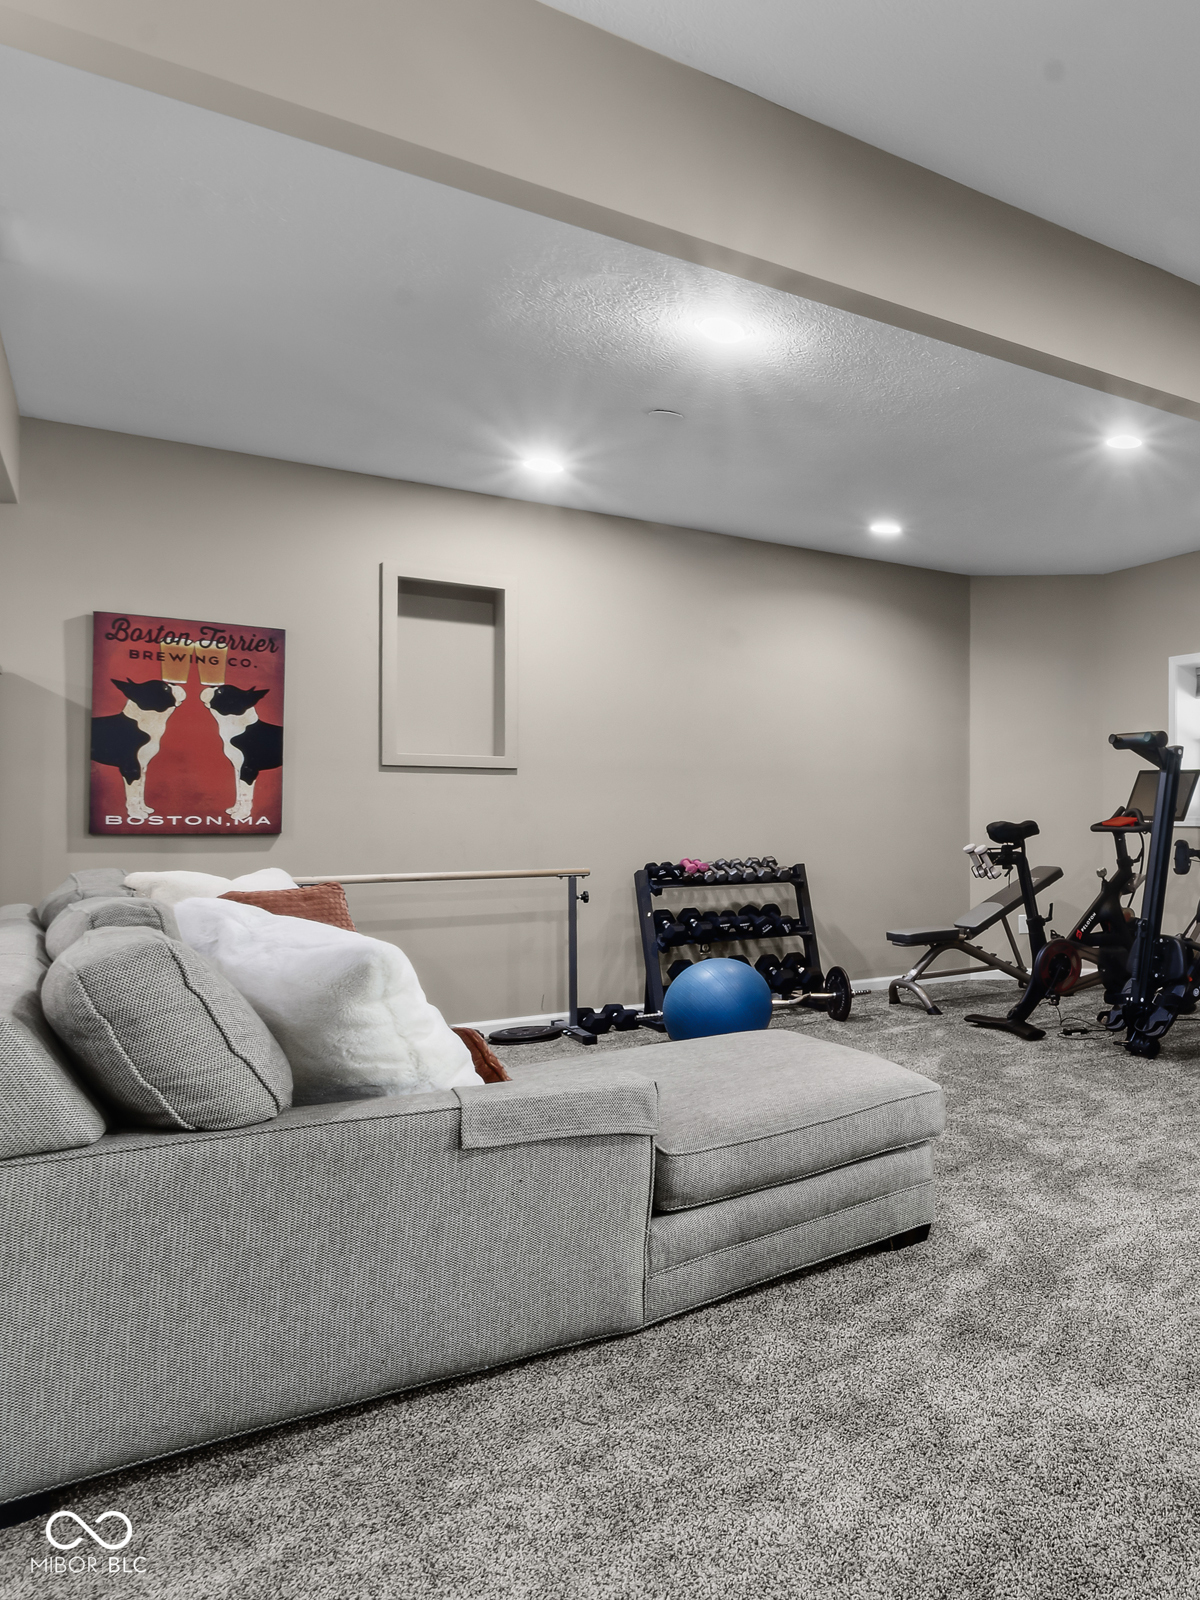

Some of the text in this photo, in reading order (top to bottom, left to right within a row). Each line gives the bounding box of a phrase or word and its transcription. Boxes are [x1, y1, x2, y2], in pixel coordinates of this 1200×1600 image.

[105, 618, 279, 653] Boston Terrier
[129, 650, 258, 669] BREWING CO.
